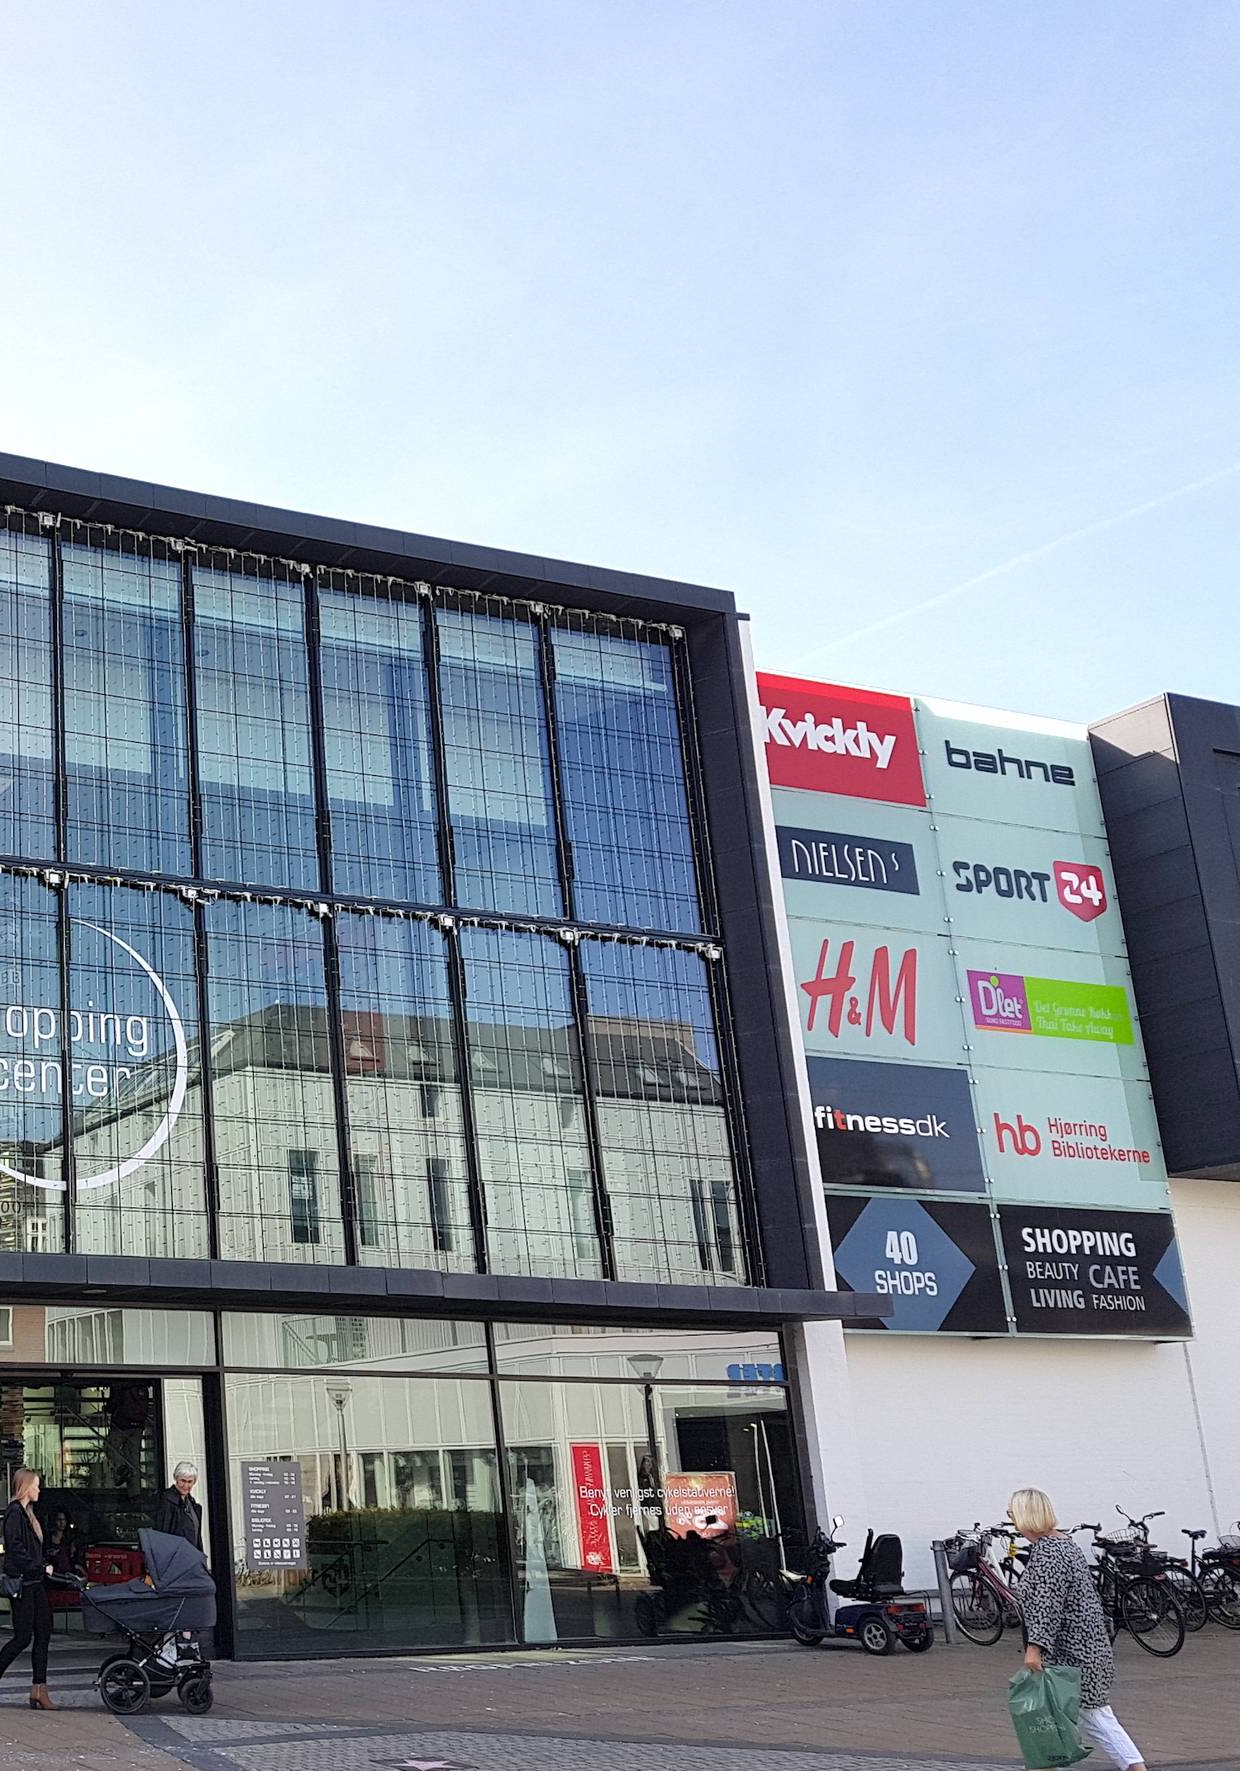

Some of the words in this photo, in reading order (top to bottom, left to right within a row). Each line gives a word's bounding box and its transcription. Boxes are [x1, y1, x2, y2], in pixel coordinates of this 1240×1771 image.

[759, 705, 897, 769] Kvickly
[945, 740, 1076, 787] bahne
[952, 860, 1051, 903] SPORT
[1059, 869, 1104, 907] 24
[800, 938, 917, 1046] H&M
[813, 1105, 950, 1139] fitnessdk
[993, 1112, 1042, 1156] hb
[1048, 1116, 1108, 1142] Hjørring
[1051, 1139, 1151, 1164] Bibliotekerne
[884, 1230, 919, 1265] 40
[1021, 1227, 1137, 1258] SHOPPING
[873, 1270, 938, 1297] SHOPS
[1026, 1260, 1080, 1281] BEAUTY
[1088, 1264, 1142, 1290] CAFE
[1030, 1288, 1086, 1310] LIVING
[1092, 1293, 1146, 1311] FASHION
[579, 1486, 614, 1500] Benyt
[614, 1486, 655, 1501] venligst
[590, 1503, 625, 1519] Cykler
